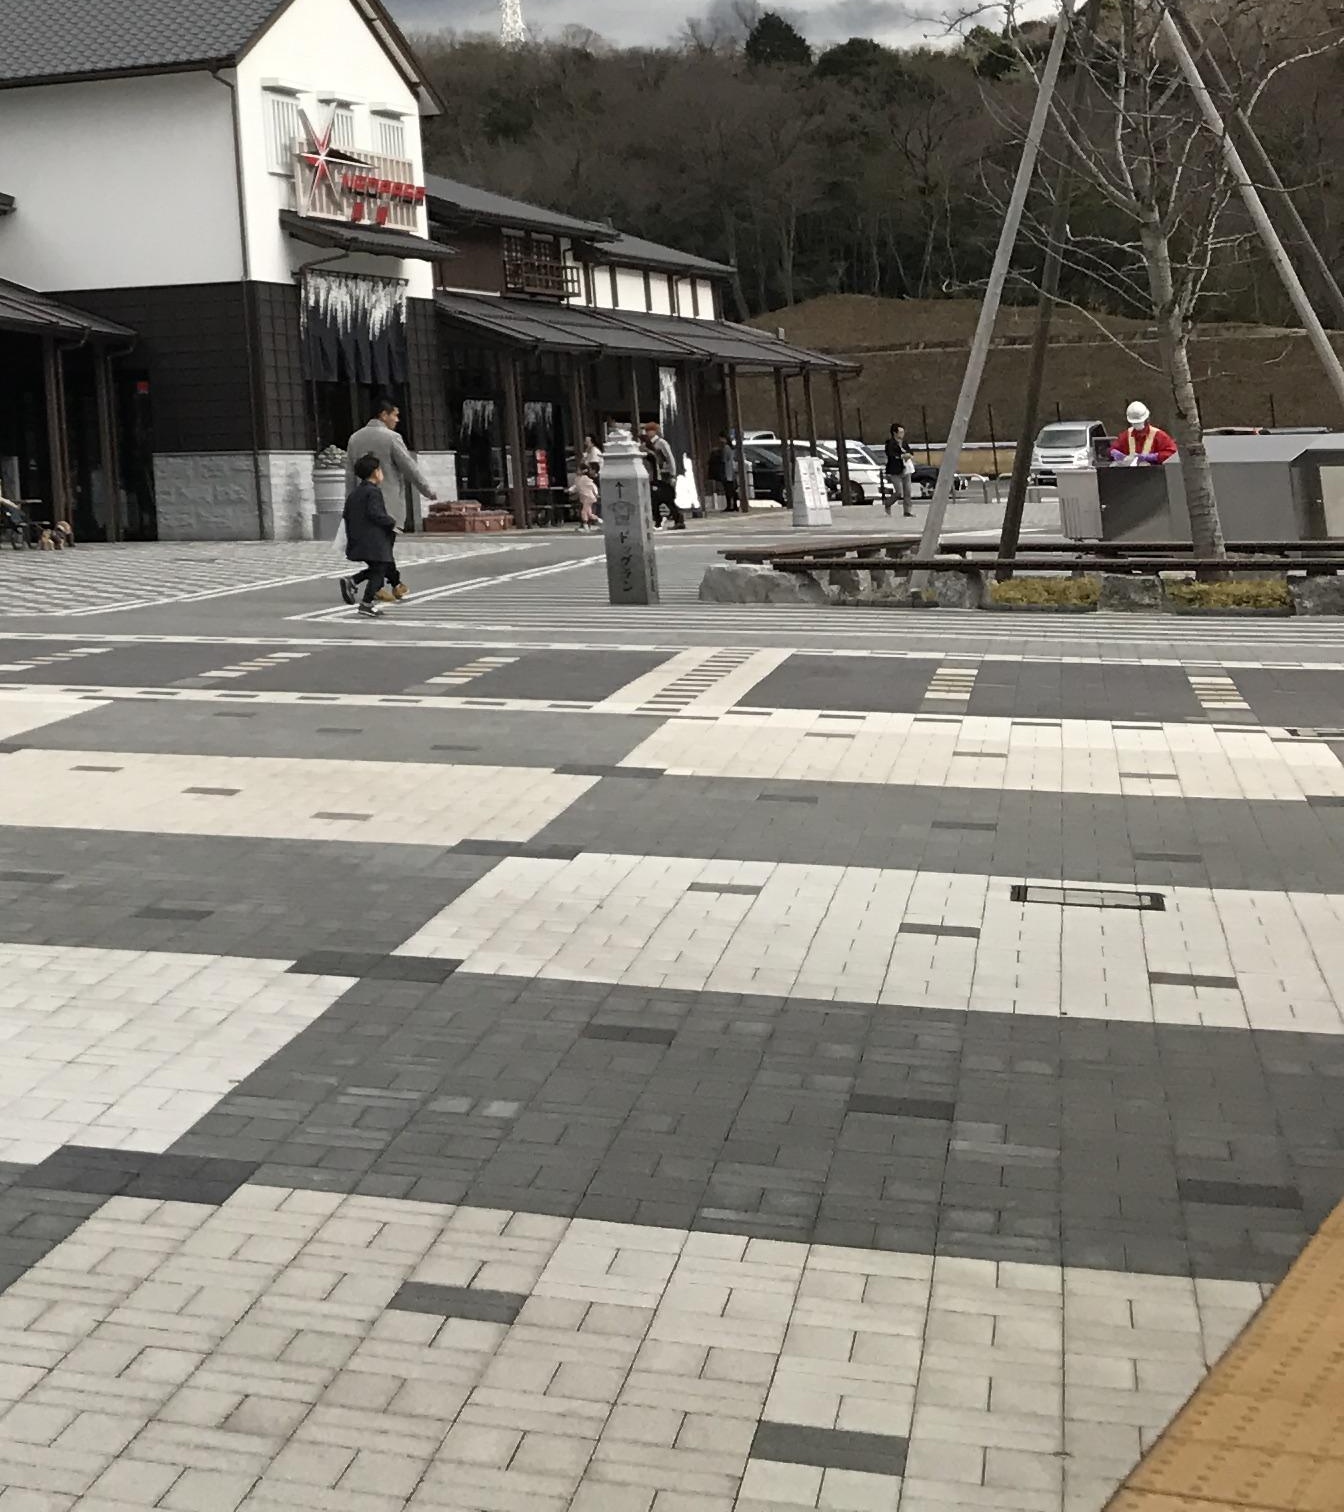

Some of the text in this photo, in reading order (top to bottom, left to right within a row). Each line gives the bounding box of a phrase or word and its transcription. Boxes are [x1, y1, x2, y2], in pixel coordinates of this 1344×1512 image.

[618, 531, 634, 592] ドッグラン
